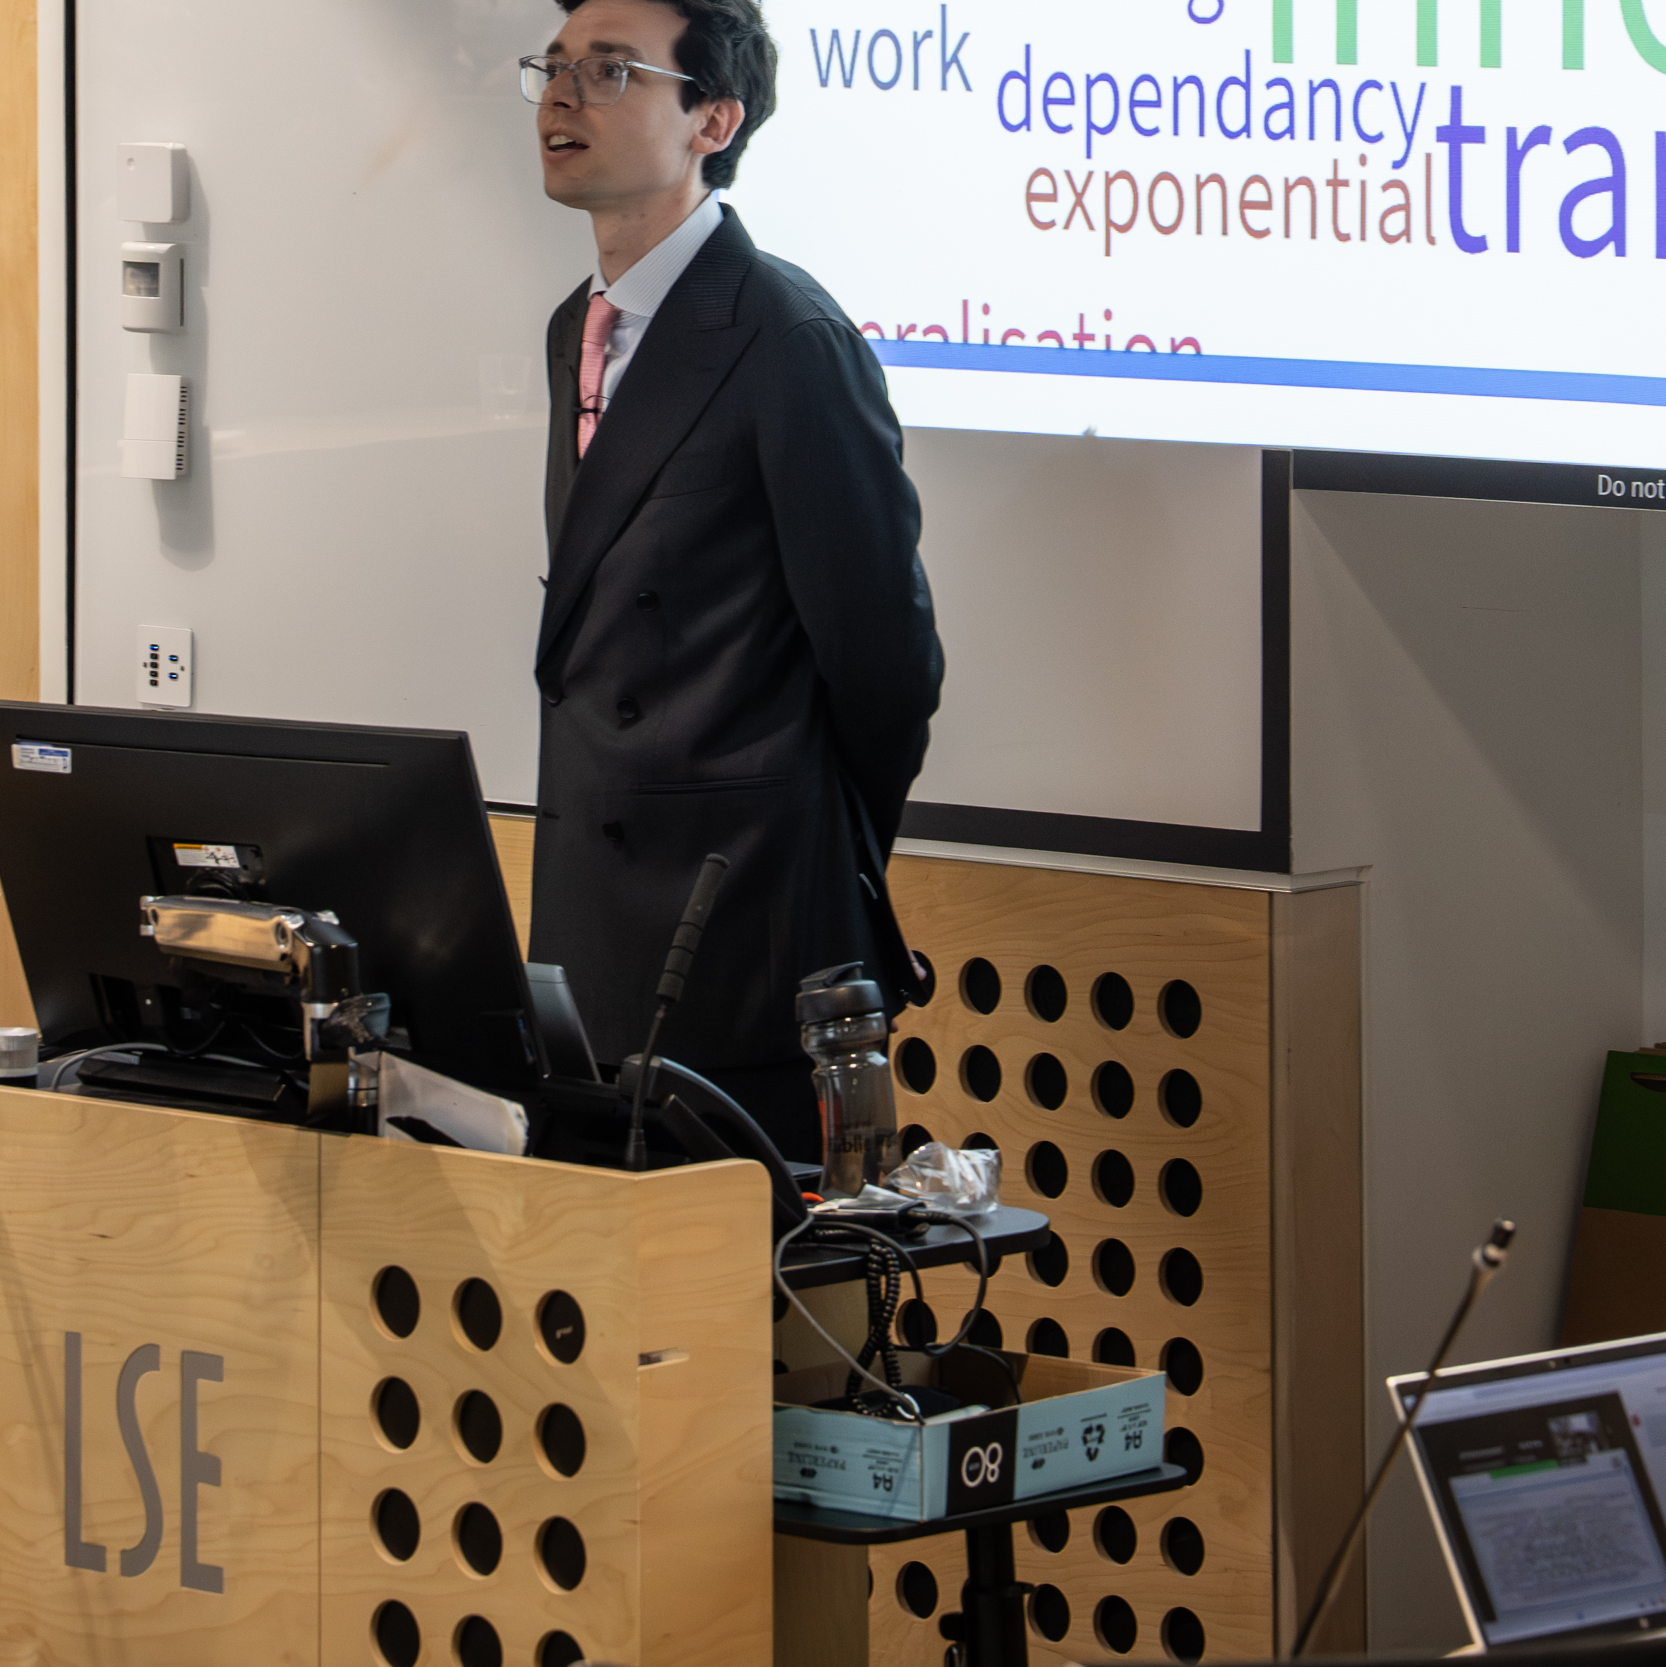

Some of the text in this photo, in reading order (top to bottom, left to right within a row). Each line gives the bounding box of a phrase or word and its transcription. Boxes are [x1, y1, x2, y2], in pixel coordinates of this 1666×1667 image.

[809, 3, 973, 92] work
[997, 43, 1427, 170] dependancy
[1025, 152, 1436, 257] exponential
[1597, 474, 1626, 497] Do
[1631, 478, 1665, 500] not
[65, 1331, 224, 1594] LSE
